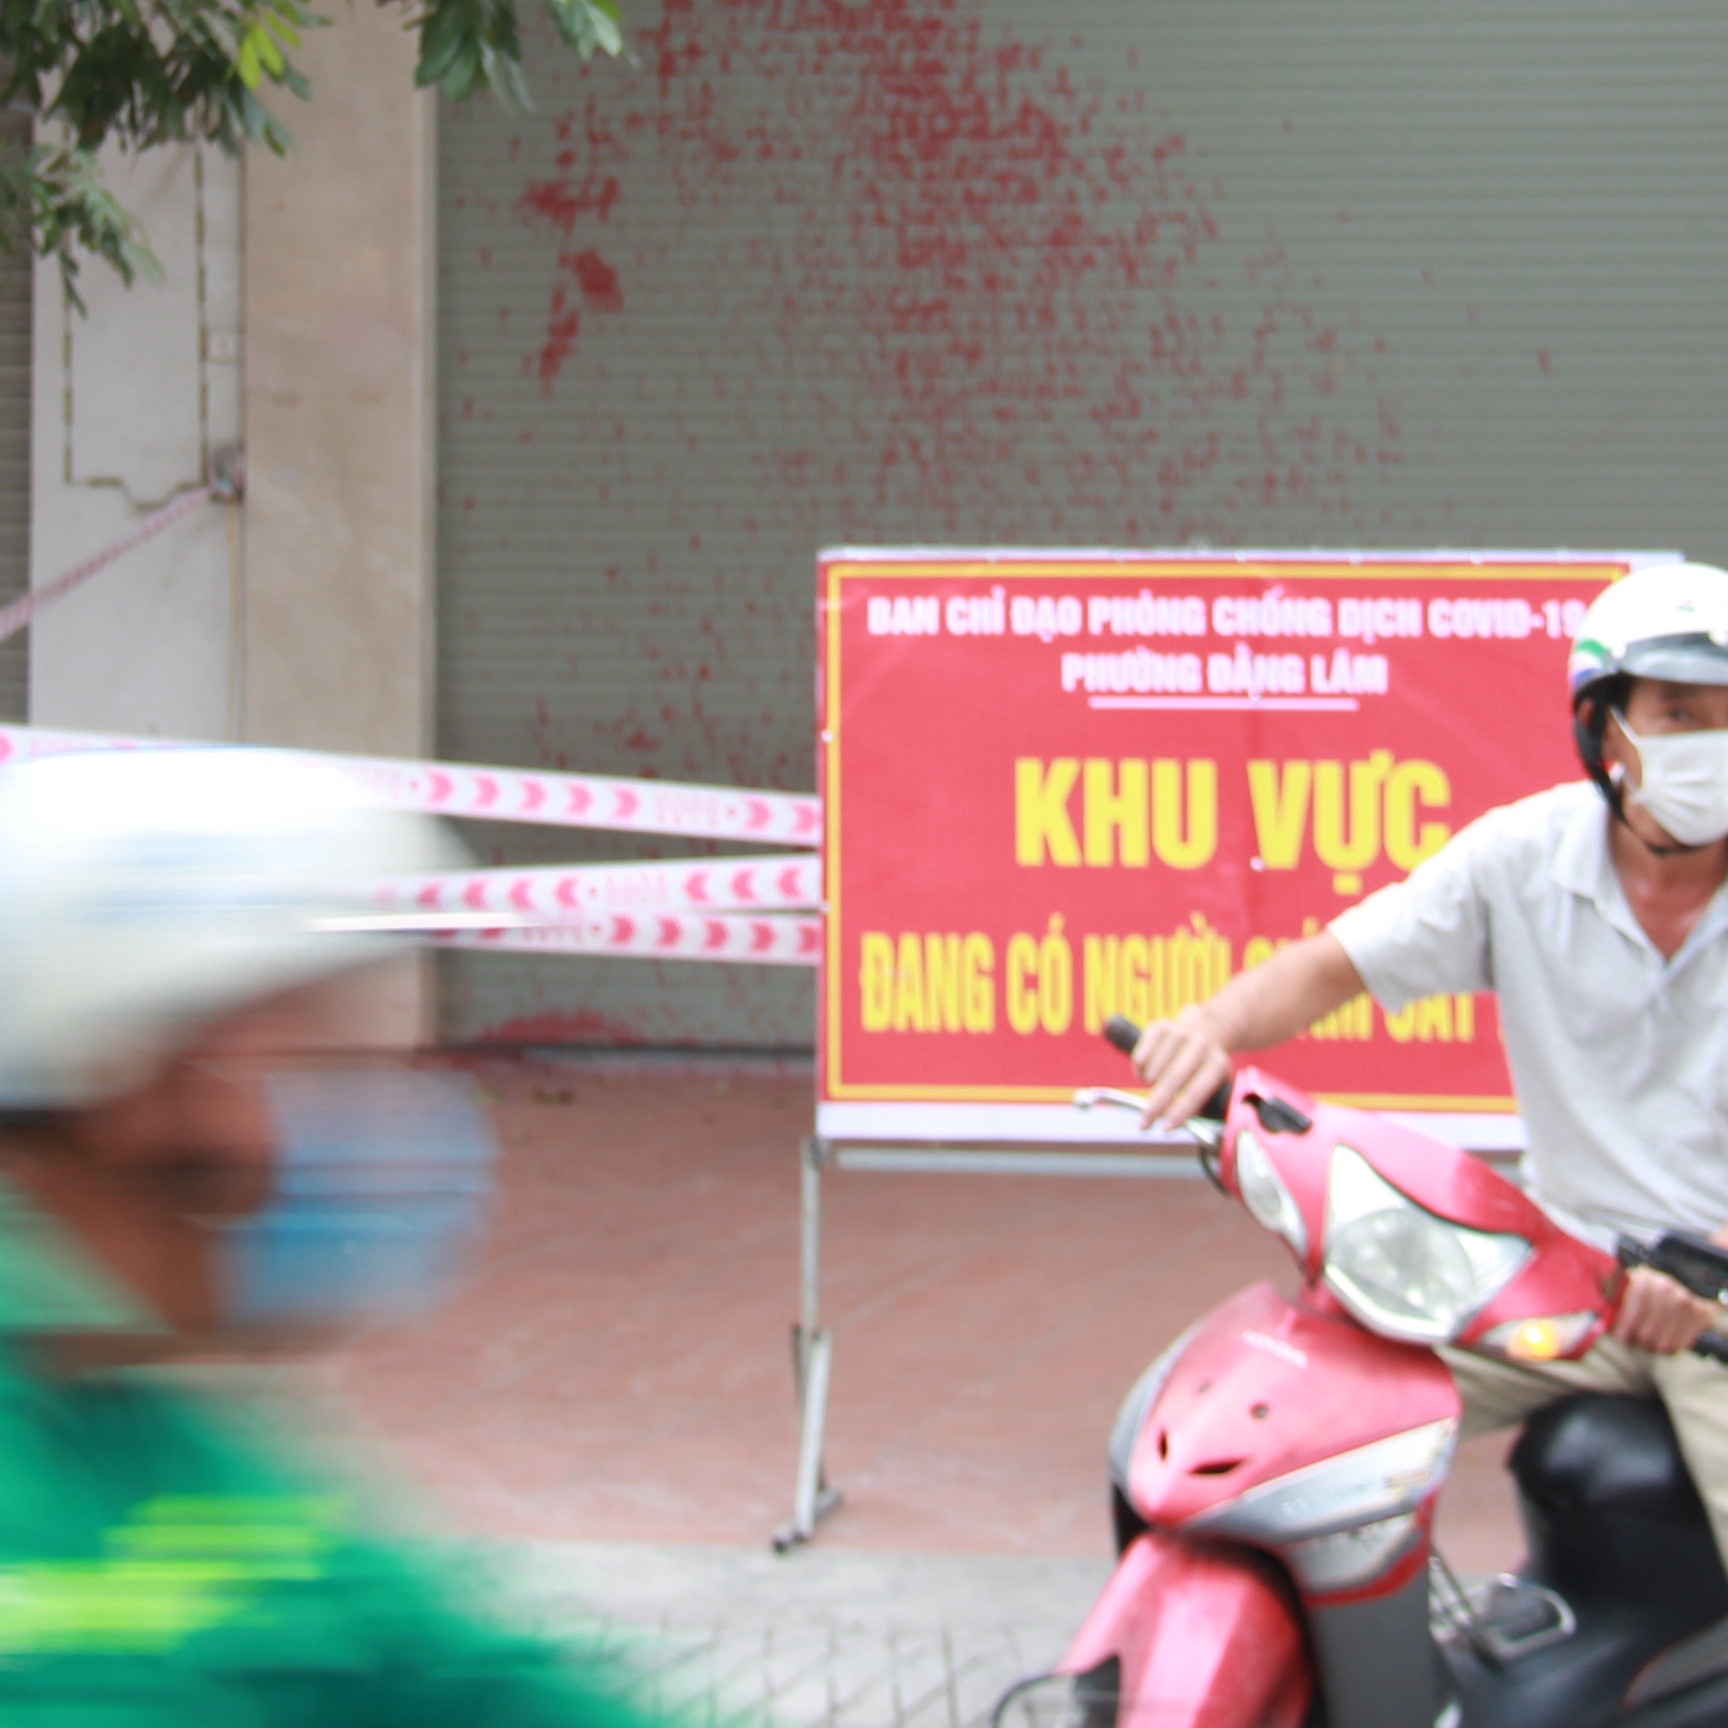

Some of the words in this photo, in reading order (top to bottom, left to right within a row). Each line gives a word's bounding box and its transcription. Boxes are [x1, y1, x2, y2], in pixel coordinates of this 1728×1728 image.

[867, 595, 939, 636] BAN
[945, 586, 1005, 636] CHỈ
[1010, 596, 1082, 645] ĐẠO
[1088, 591, 1207, 638] PHÒNG
[1014, 757, 1219, 869] KHU
[1247, 748, 1453, 896] VỰC
[860, 929, 996, 1032] ĐANG
[1006, 912, 1072, 1036] CÓ
